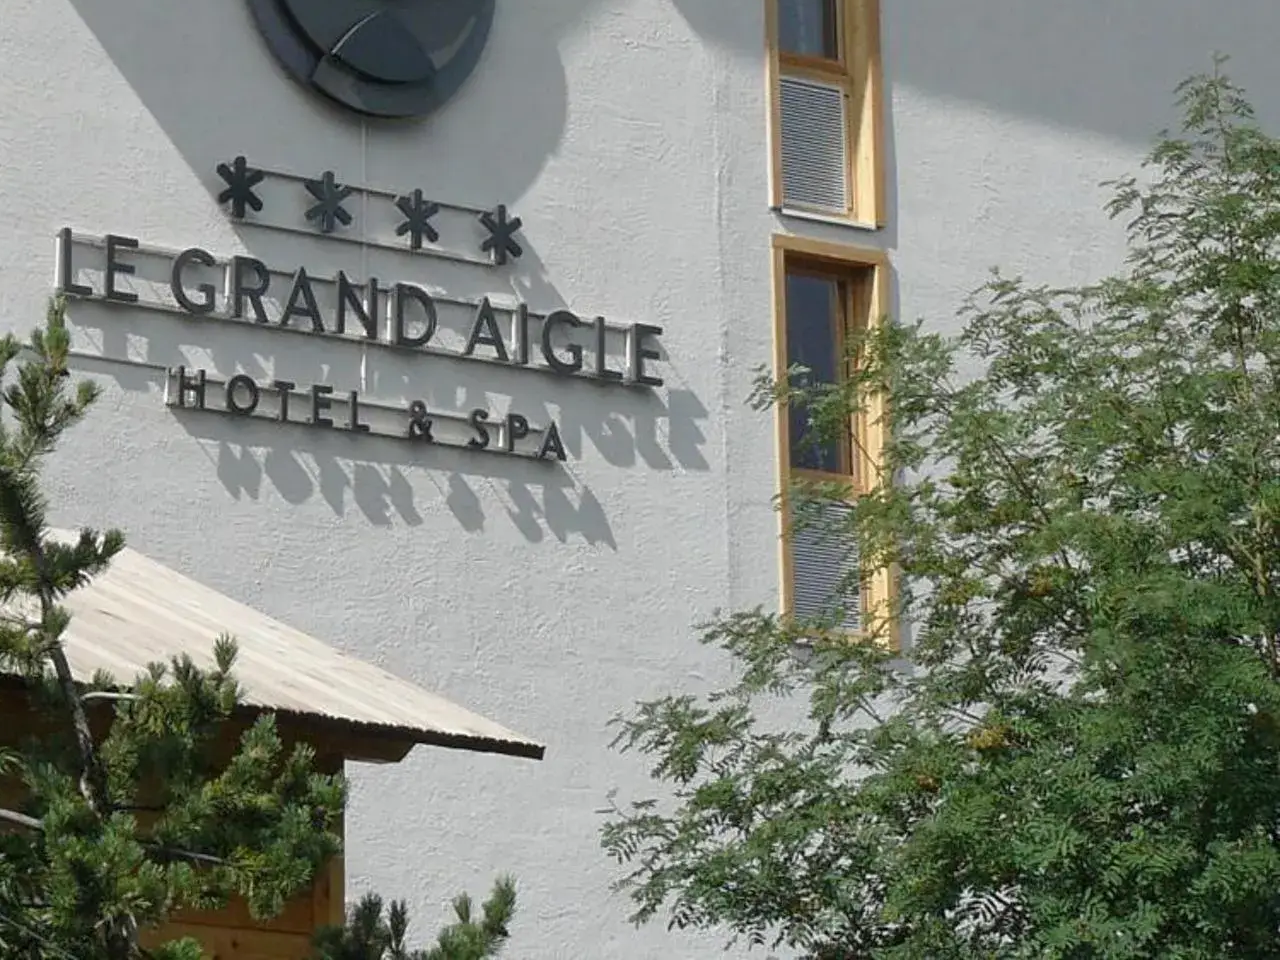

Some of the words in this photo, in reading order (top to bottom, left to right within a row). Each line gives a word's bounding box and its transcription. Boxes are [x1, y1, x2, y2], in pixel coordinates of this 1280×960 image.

[60, 227, 139, 303] LE
[171, 247, 437, 348] GRAND
[464, 295, 664, 387] AIGLE
[177, 365, 370, 432] HOTEL
[409, 399, 434, 442] &
[469, 408, 567, 461] SPA
